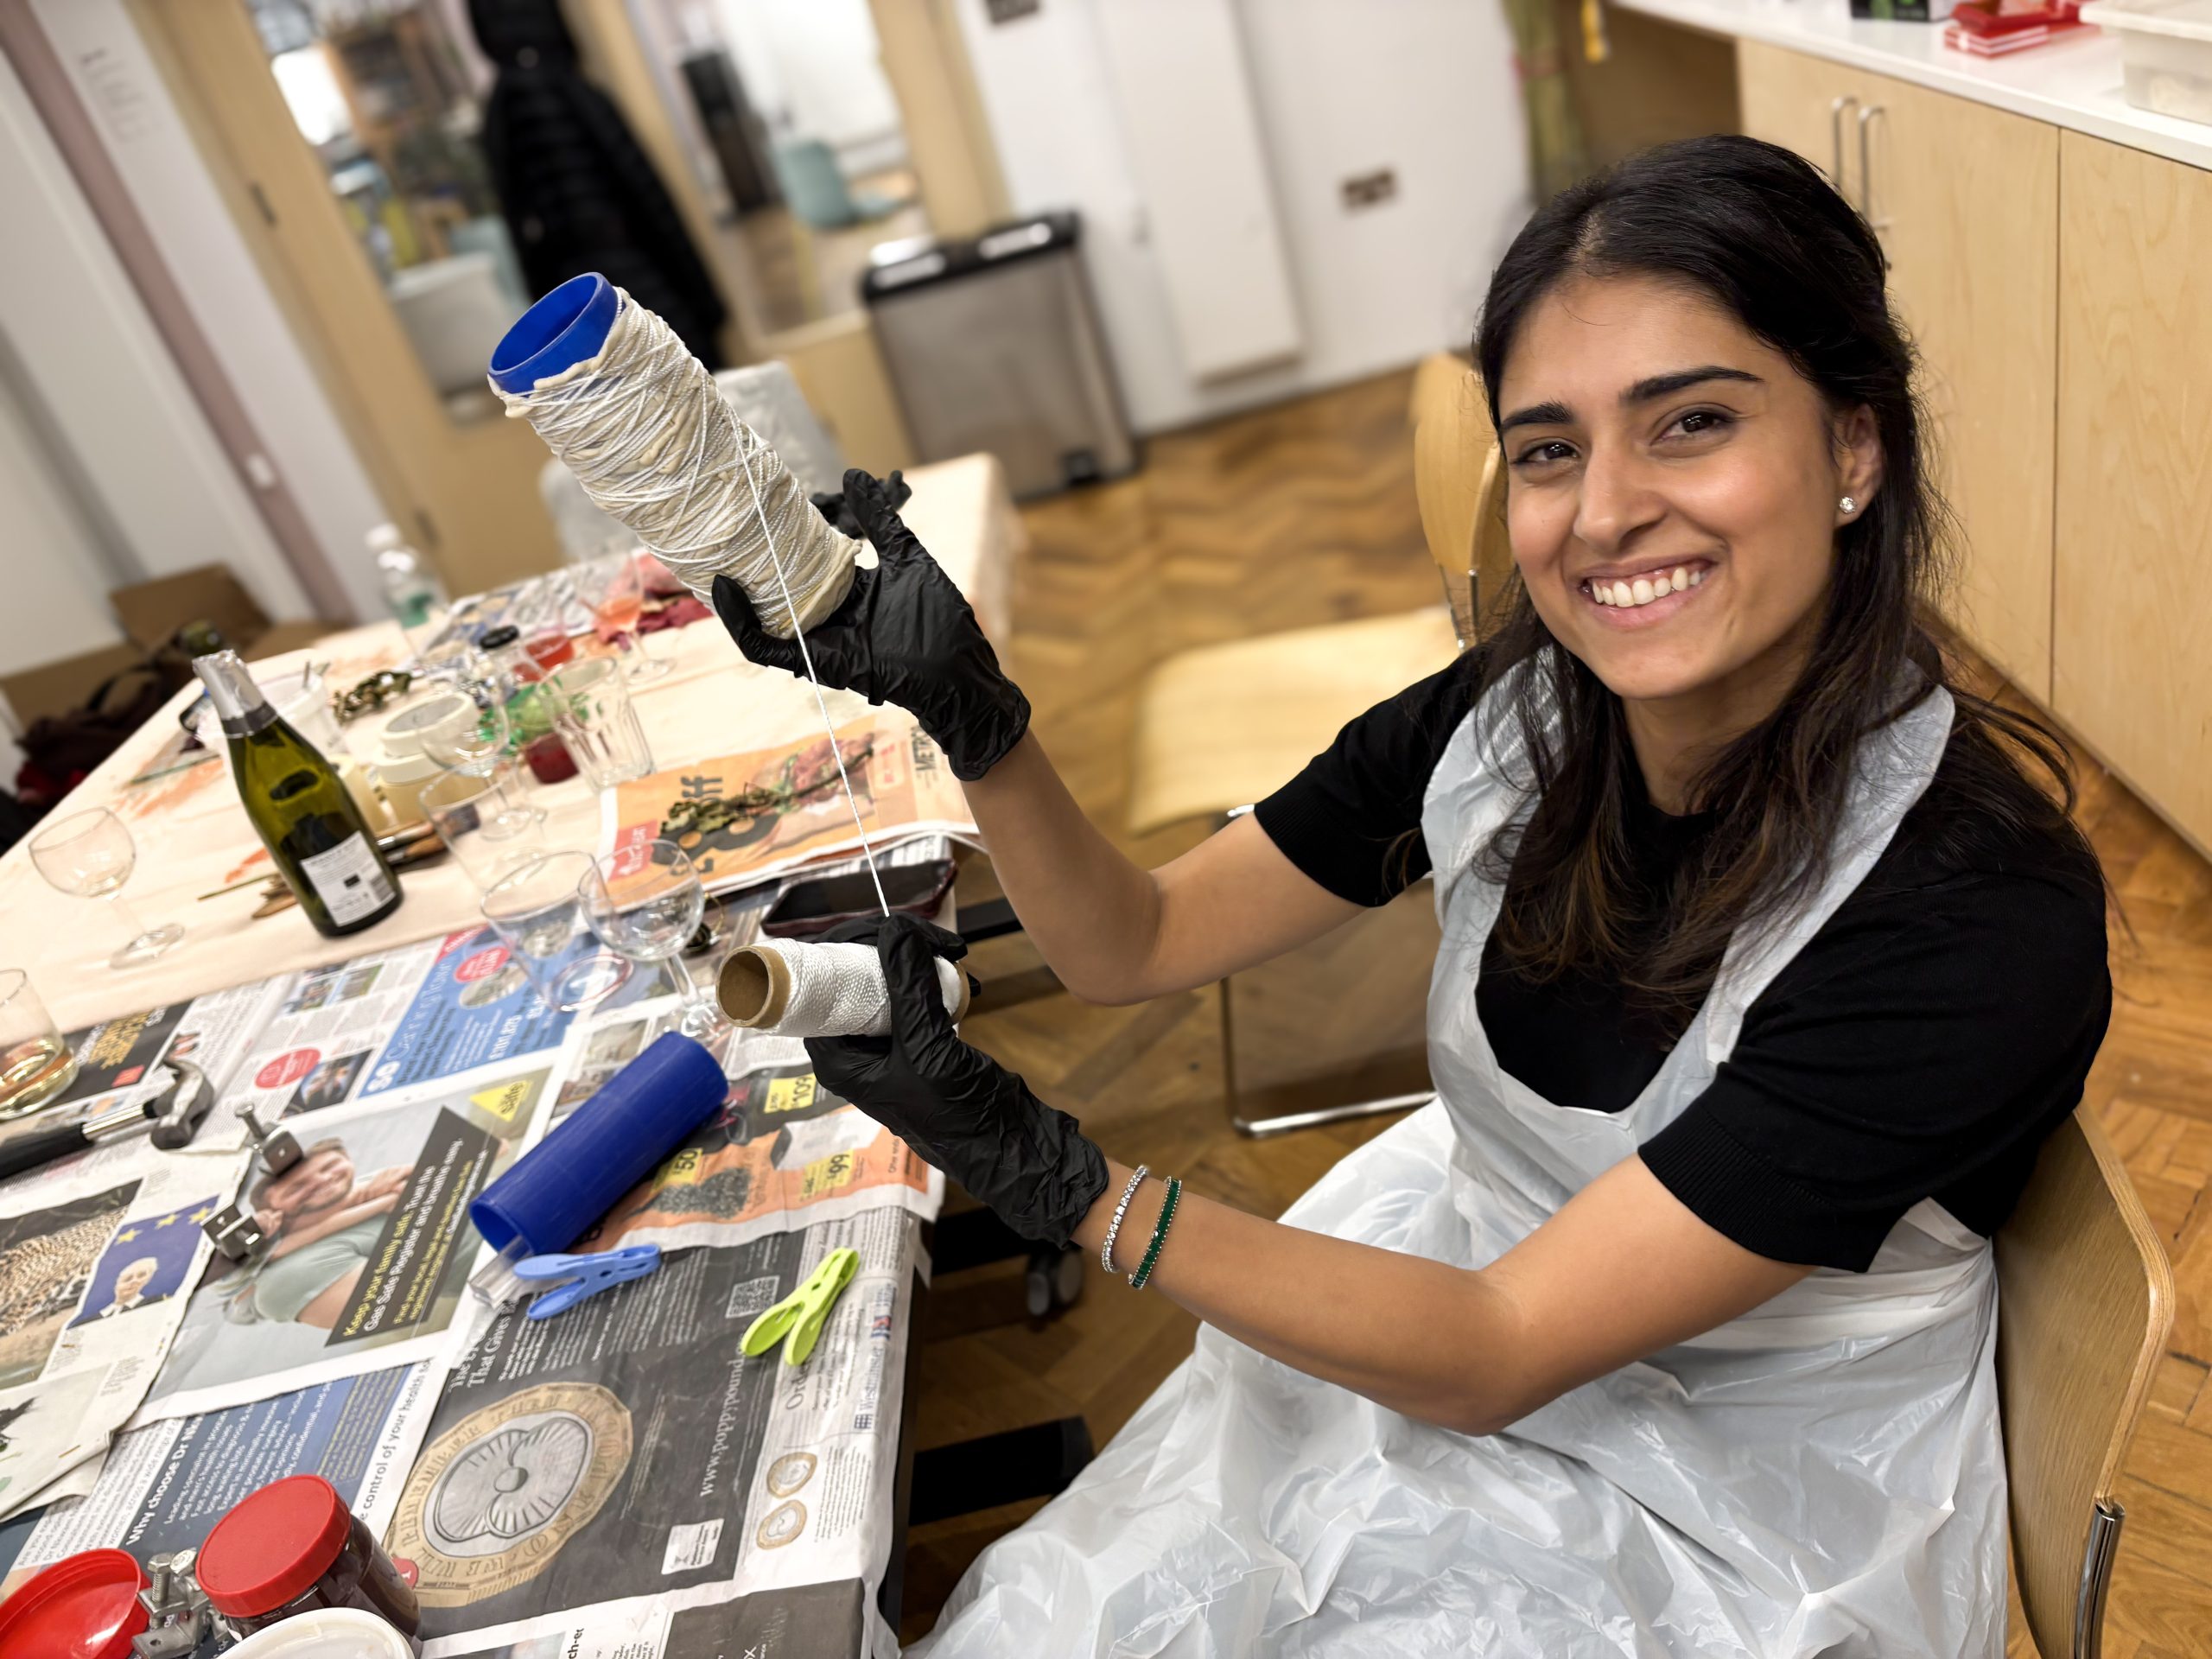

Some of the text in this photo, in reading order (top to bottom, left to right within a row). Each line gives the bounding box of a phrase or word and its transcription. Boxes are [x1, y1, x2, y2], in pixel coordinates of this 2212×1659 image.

[422, 1165, 452, 1206] breathe
[411, 1205, 433, 1227] and
[342, 1165, 436, 1336] Keep your family safe. Trust the
[388, 1227, 425, 1275] Register
[374, 1274, 401, 1304] Safe
[362, 1304, 388, 1331] Gas
[465, 1354, 497, 1388] That
[481, 1314, 512, 1353] Gives
[397, 1374, 427, 1411] health
[859, 1345, 884, 1410] Westminster
[386, 1412, 409, 1440] your
[199, 1469, 223, 1497] access
[217, 1421, 250, 1459] diagnosis
[377, 1444, 397, 1459] of
[104, 1512, 131, 1544] women,
[123, 1486, 145, 1510] across
[137, 1459, 160, 1478] wide
[149, 1437, 175, 1458] range
[123, 1511, 157, 1545] Why
[143, 1461, 182, 1509] choose
[170, 1443, 191, 1459] Dr
[161, 1490, 191, 1524] Leading
[175, 1502, 194, 1520] and
[197, 1448, 222, 1476] health
[200, 1493, 223, 1515] long
[212, 1461, 240, 1493] waiting
[214, 1483, 241, 1510] Expert
[359, 1460, 391, 1510] control
